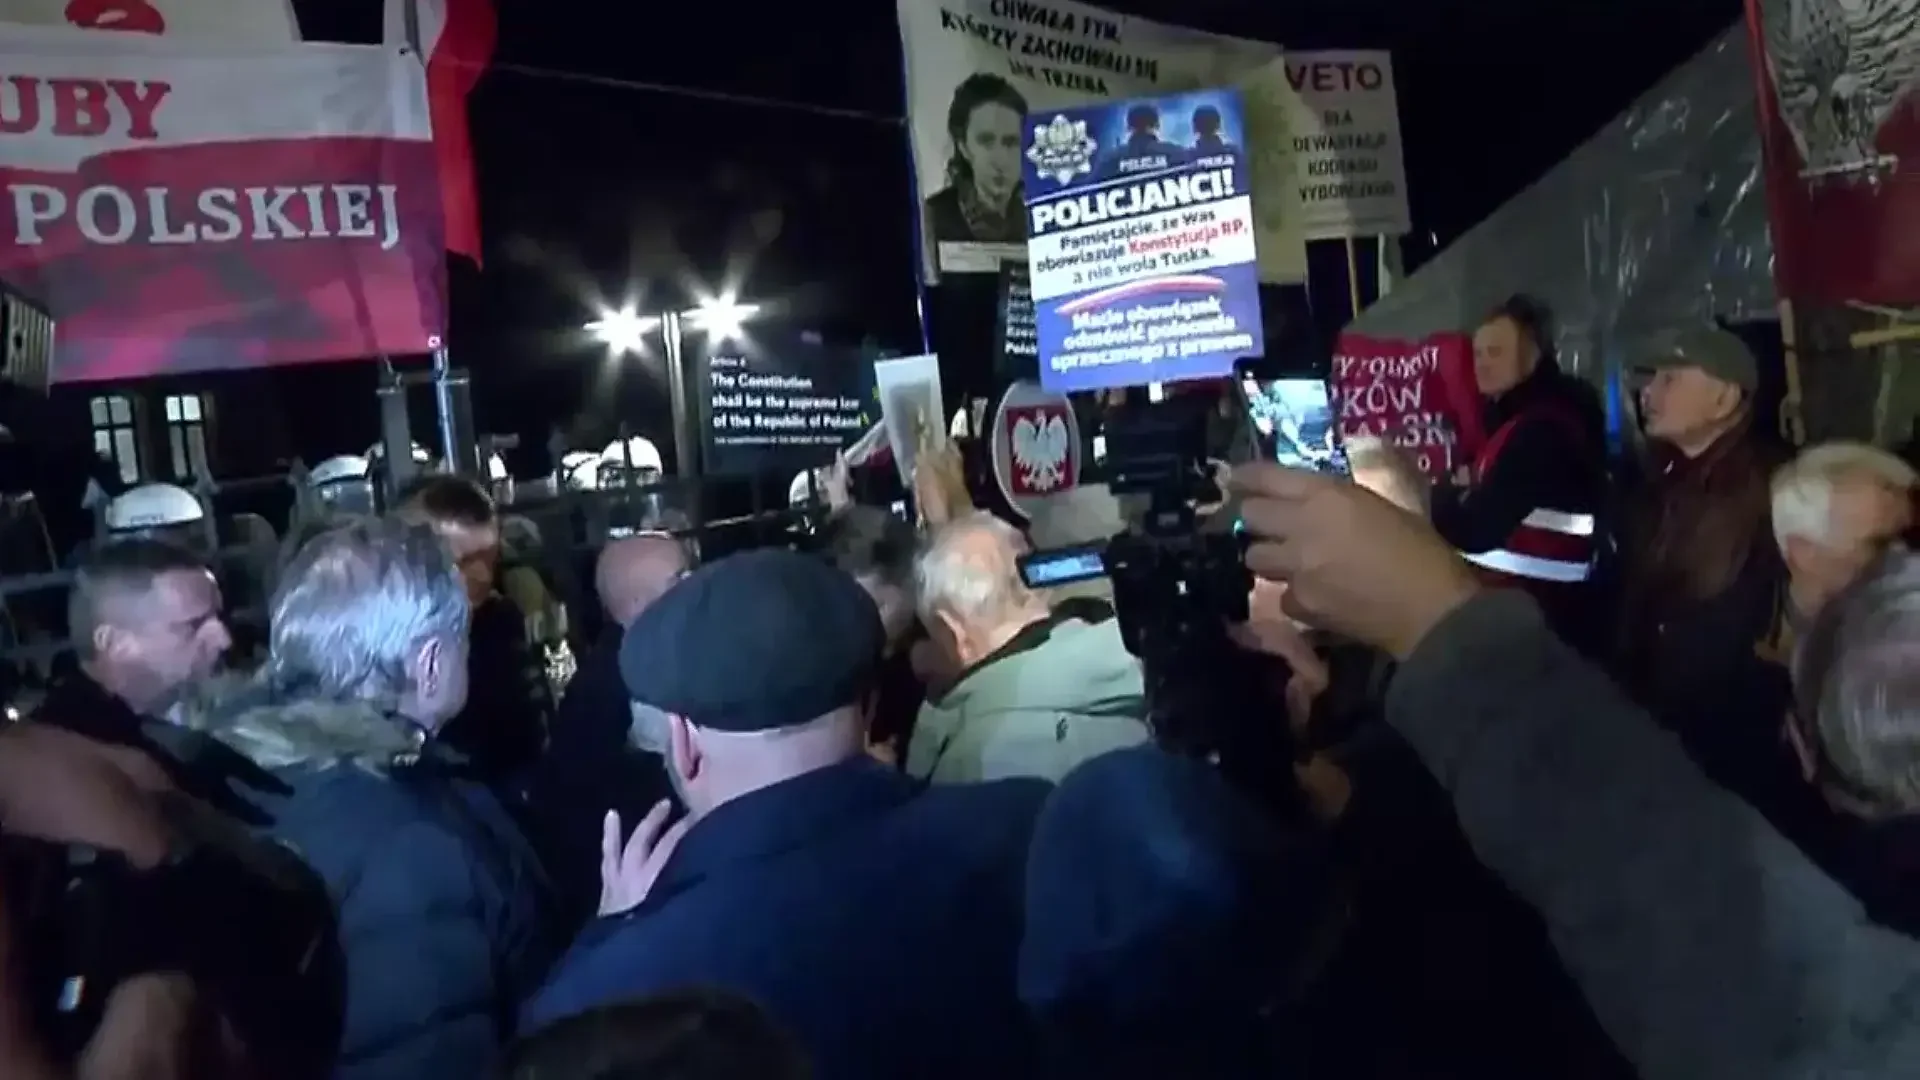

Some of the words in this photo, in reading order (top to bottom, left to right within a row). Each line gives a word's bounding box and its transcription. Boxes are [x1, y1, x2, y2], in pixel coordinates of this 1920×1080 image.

[990, 0, 1075, 33] CHWAŁA
[1021, 34, 1131, 75] ZACHOWALI
[1041, 67, 1108, 96] TRZEBA
[1284, 62, 1382, 92] VETO
[1032, 168, 1236, 234] POLICJANCI!
[7, 183, 400, 250] POLSKIEJ
[1182, 209, 1216, 226] Was
[1129, 224, 1219, 255] Konstytucja
[1073, 271, 1083, 285] a
[1088, 265, 1114, 283] nie
[1117, 257, 1157, 276] wola
[1126, 295, 1223, 322] obowiązek
[1149, 316, 1236, 344] polecenia
[1050, 344, 1165, 374] sprzecznego
[1165, 343, 1180, 357] z
[710, 371, 735, 388] The
[737, 372, 813, 389] Constitution
[711, 392, 743, 408] shall
[745, 392, 762, 408] be
[765, 393, 786, 408] the
[788, 396, 838, 411] supreme
[840, 394, 860, 409] law
[713, 412, 727, 428] of
[729, 412, 751, 428] the
[754, 412, 807, 430] Republic
[808, 413, 821, 428] of
[823, 412, 861, 428] Poland
